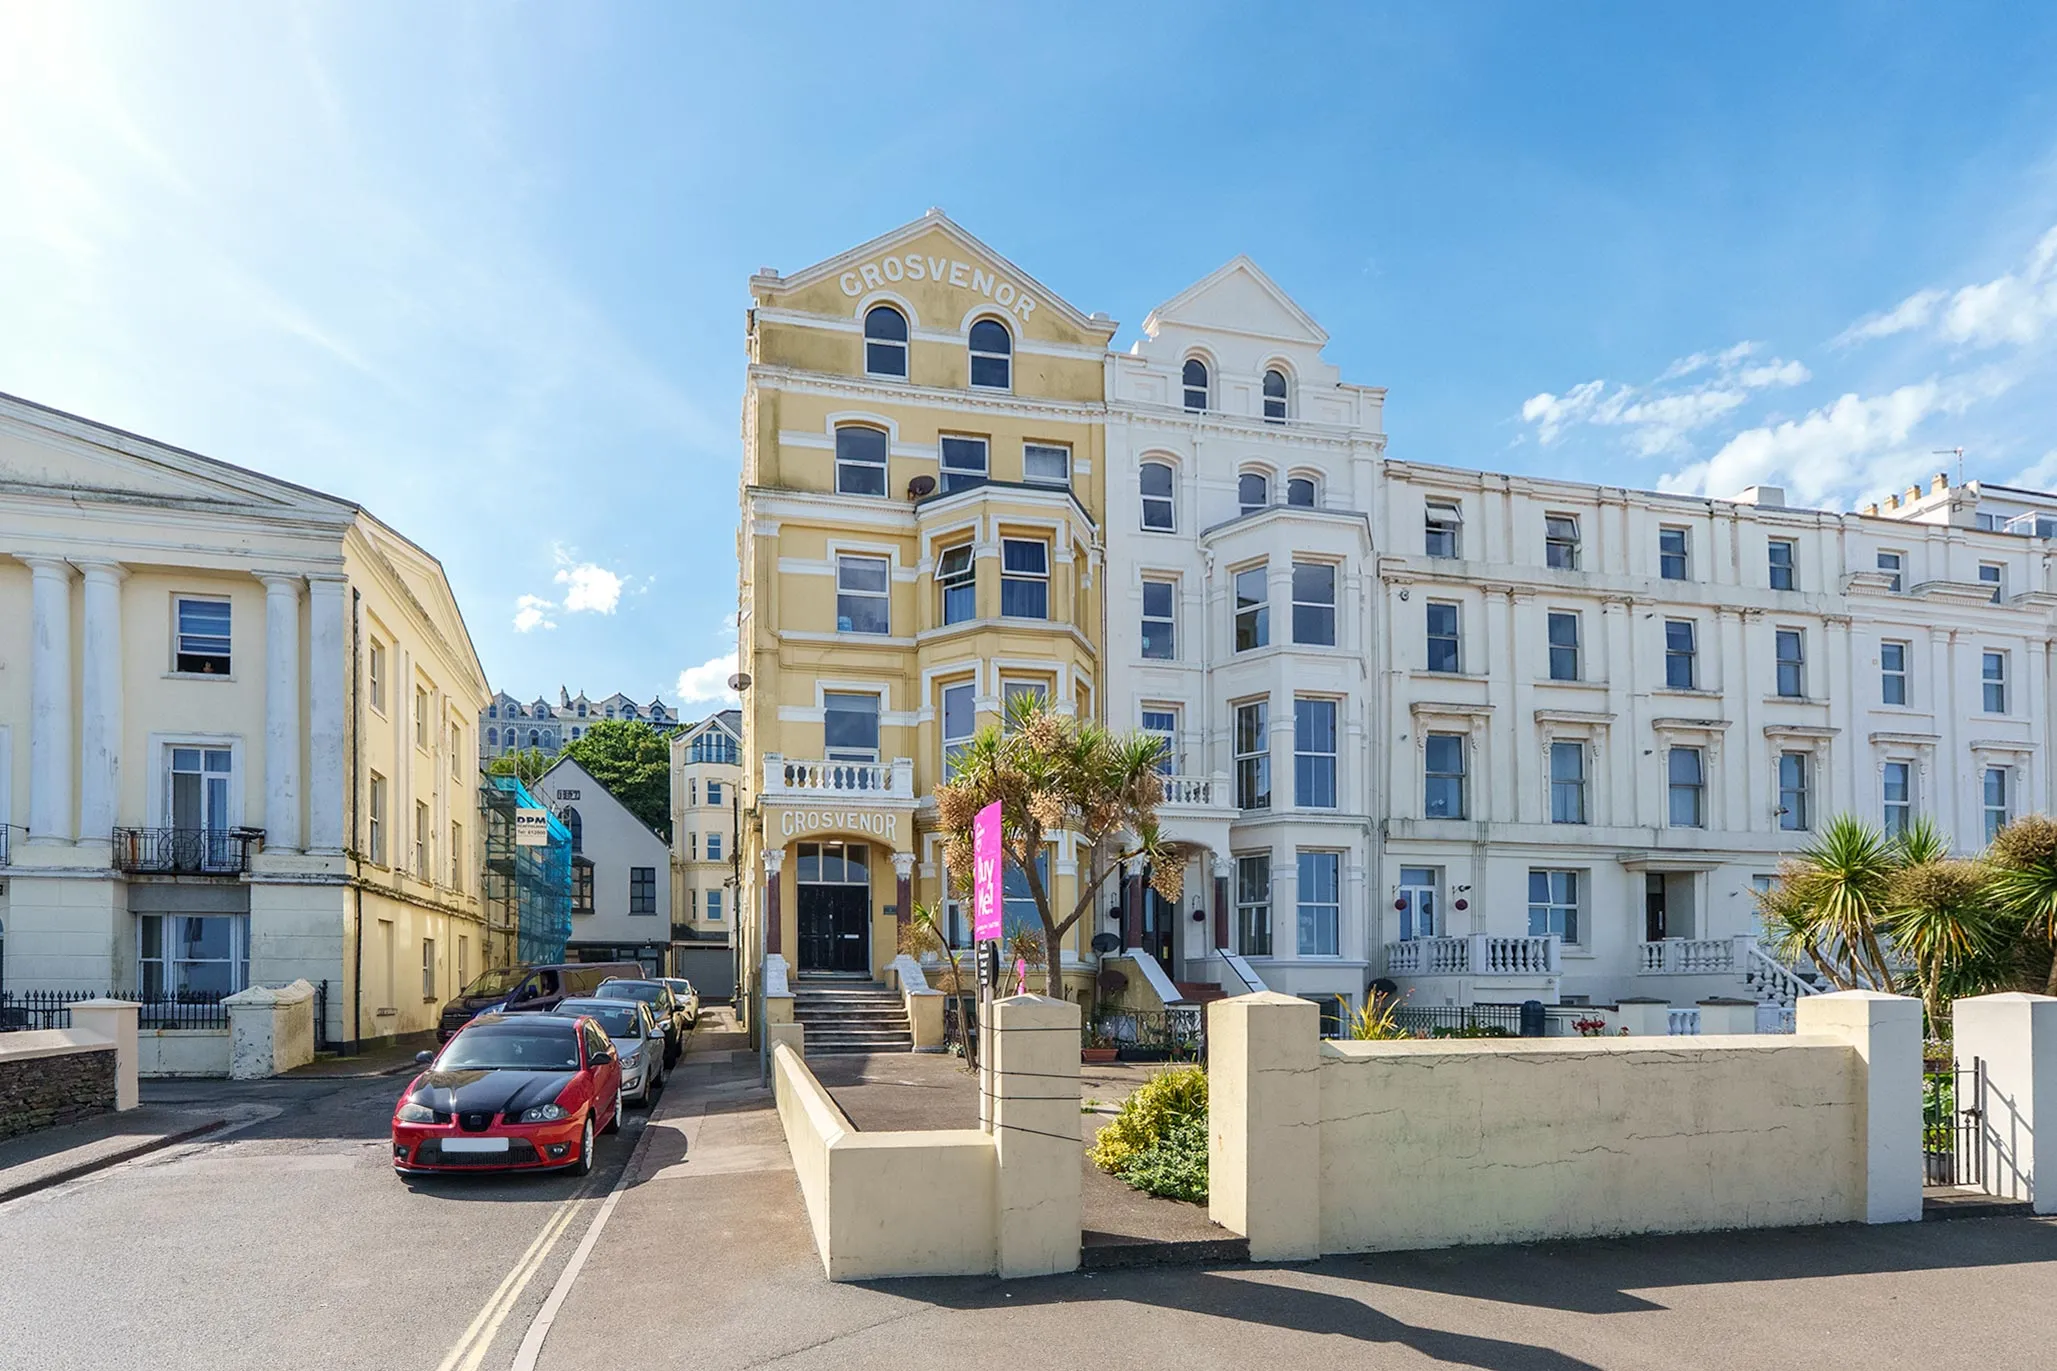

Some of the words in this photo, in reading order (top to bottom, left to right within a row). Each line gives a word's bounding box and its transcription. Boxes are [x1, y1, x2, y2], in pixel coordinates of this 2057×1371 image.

[839, 254, 1036, 322] GROSVENOR
[517, 816, 546, 824] DPM
[781, 810, 897, 841] GROSVENOR
